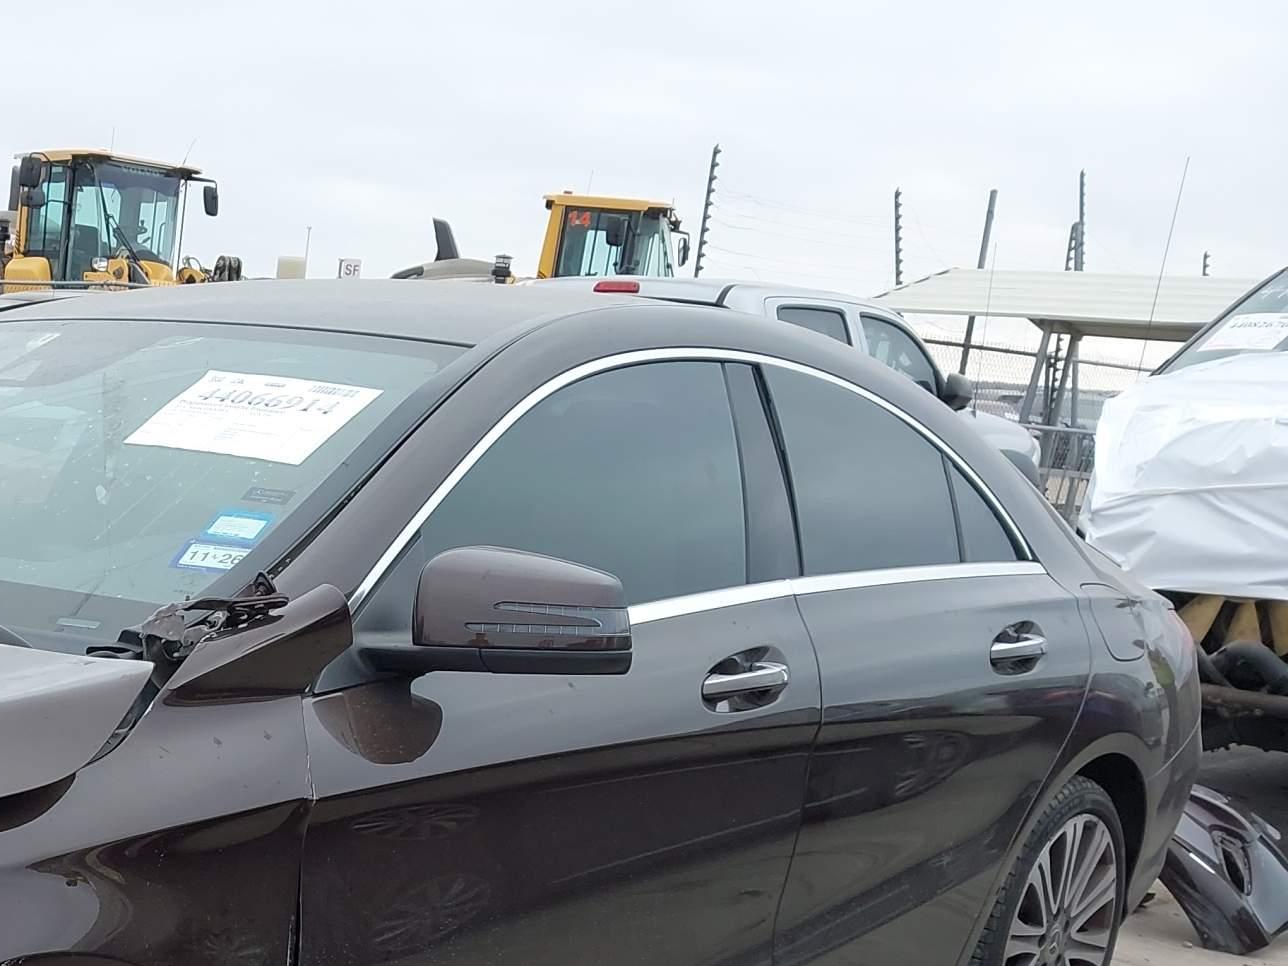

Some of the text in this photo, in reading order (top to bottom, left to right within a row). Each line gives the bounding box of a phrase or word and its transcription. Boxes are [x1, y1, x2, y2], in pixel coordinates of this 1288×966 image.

[568, 210, 591, 228] 14
[344, 263, 360, 277] SF
[198, 388, 340, 415] 44066914
[189, 550, 211, 562] 11
